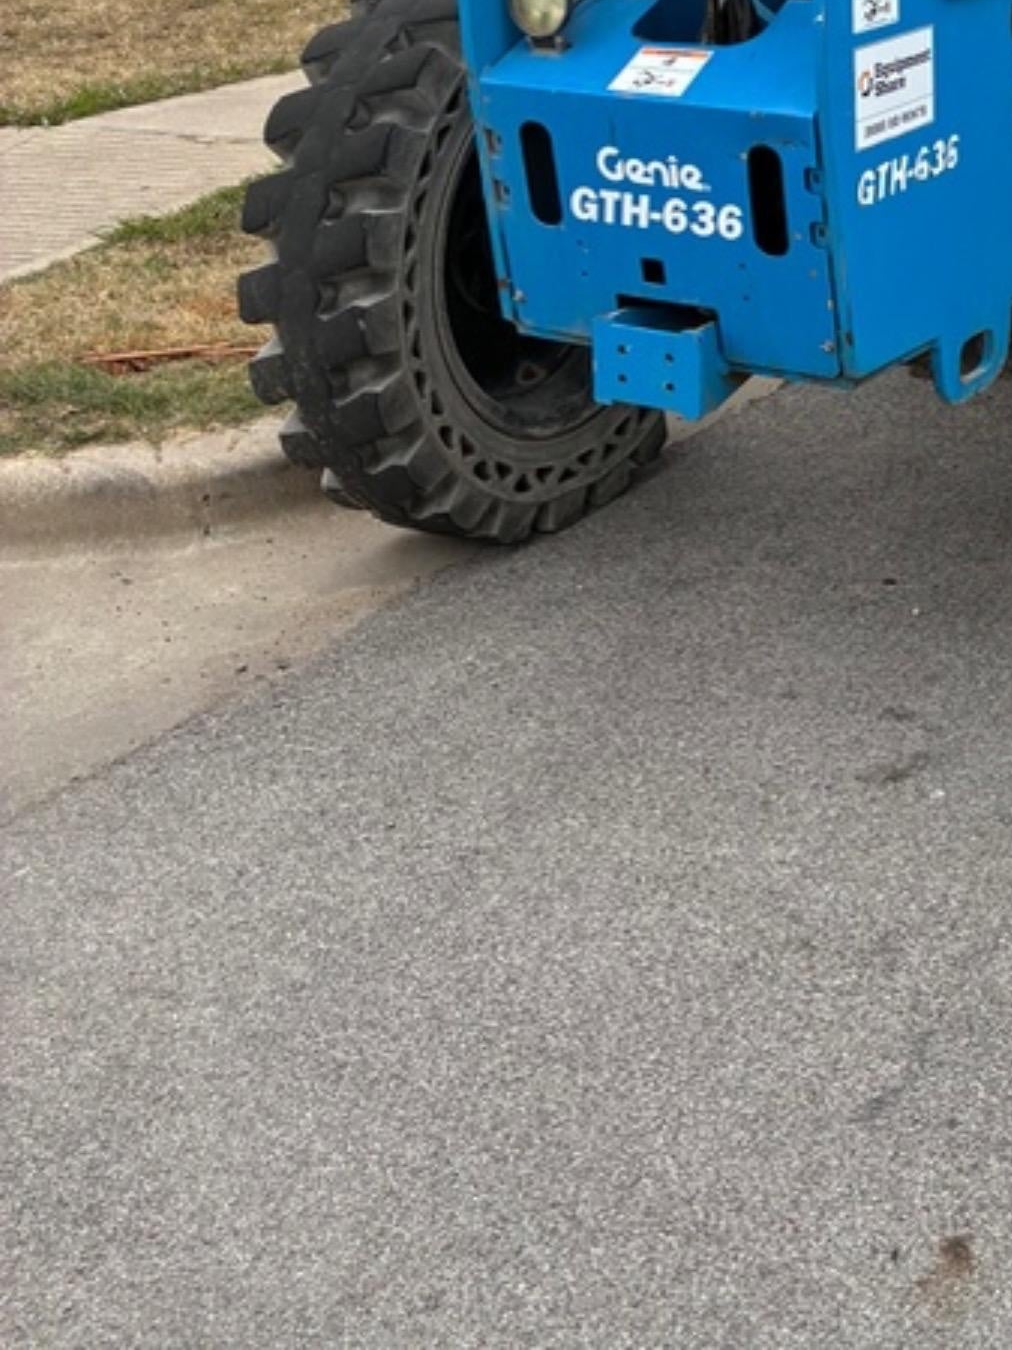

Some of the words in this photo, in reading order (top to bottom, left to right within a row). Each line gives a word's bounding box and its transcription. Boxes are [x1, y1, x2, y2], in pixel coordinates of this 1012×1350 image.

[596, 146, 708, 191] Genie
[857, 134, 959, 206] GTH-636
[570, 187, 743, 240] GTH-636
